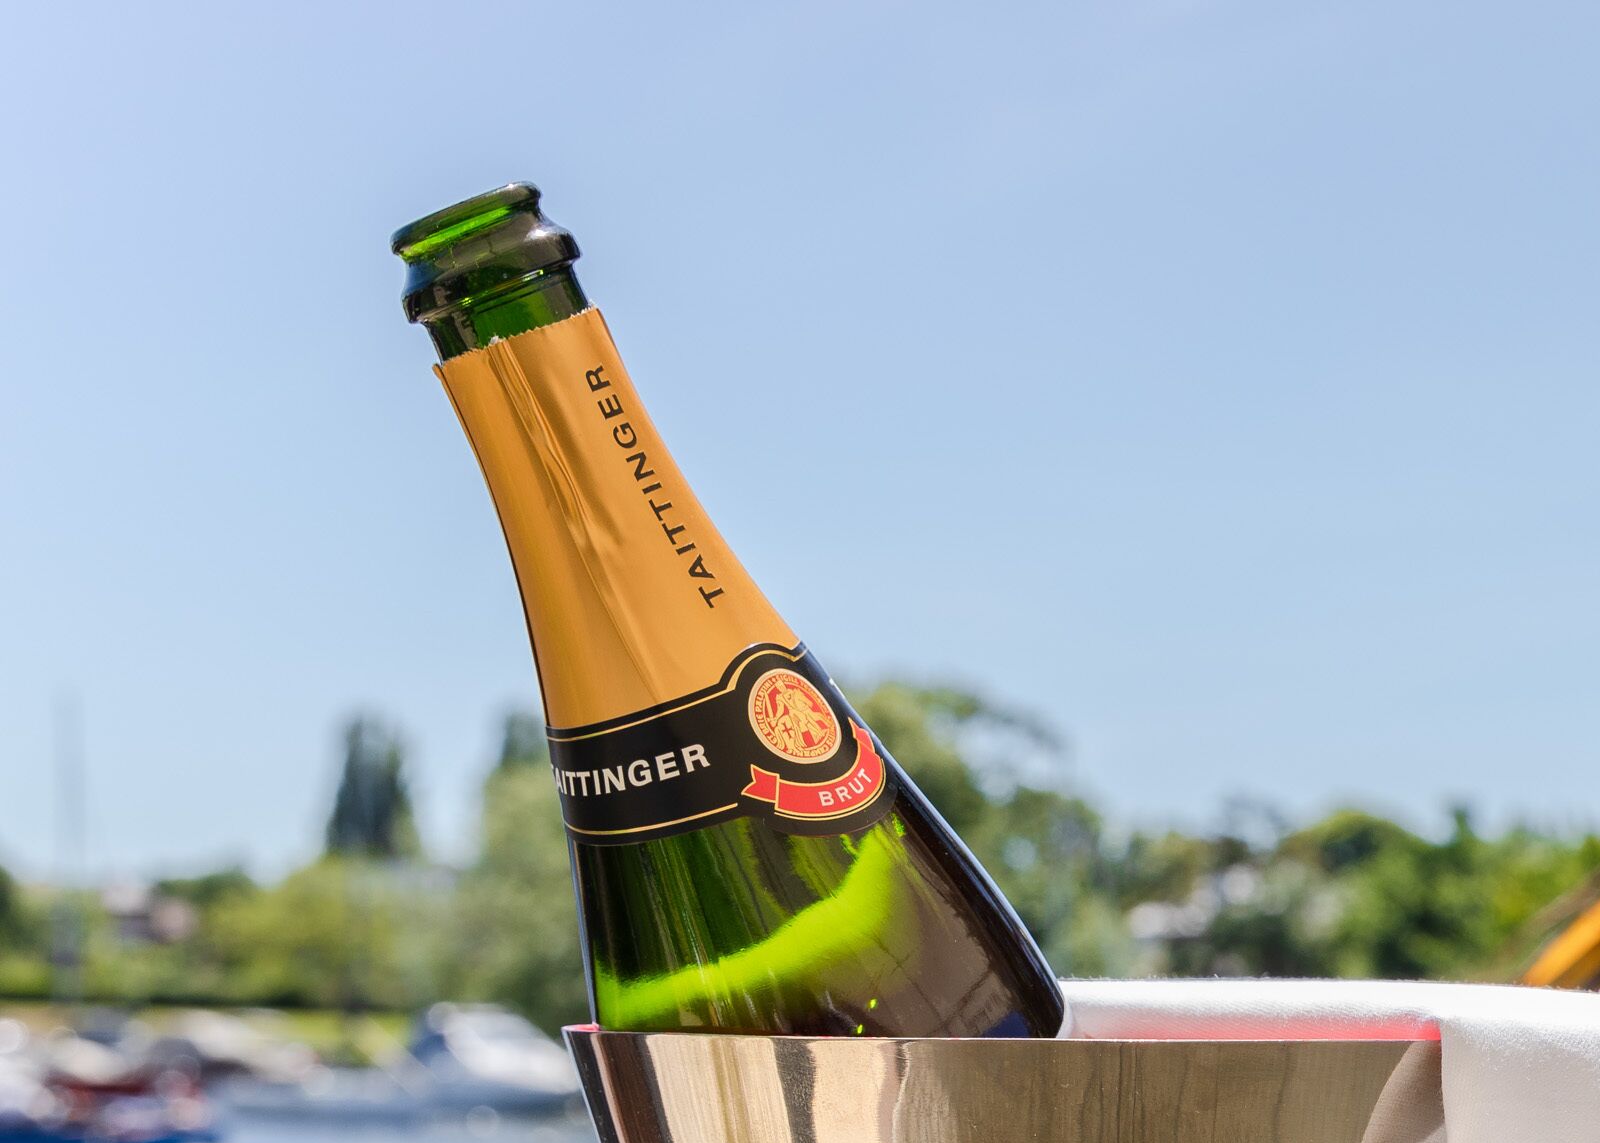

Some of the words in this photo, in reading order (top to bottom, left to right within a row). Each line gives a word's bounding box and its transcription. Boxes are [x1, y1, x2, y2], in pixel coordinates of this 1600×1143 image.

[584, 364, 726, 609] TAITTINGER
[551, 743, 711, 797] AITTINGER
[818, 768, 872, 807] BRUT
